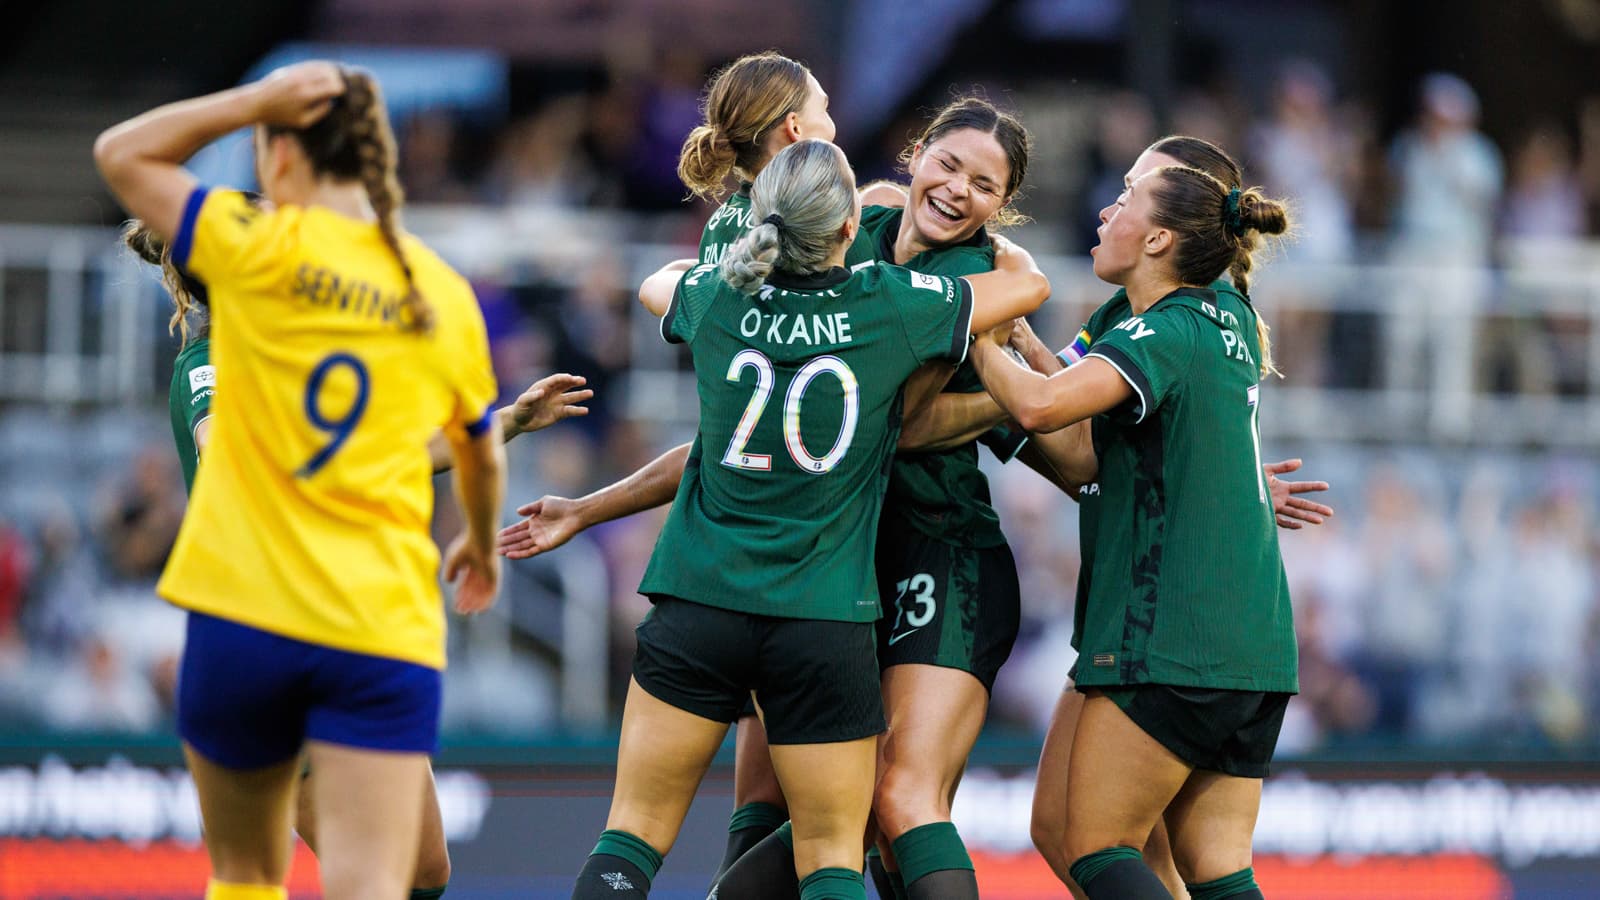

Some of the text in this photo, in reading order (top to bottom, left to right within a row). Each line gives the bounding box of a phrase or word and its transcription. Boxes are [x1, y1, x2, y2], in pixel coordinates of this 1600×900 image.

[740, 308, 852, 346] O'KANE
[1111, 316, 1156, 340] lly
[191, 389, 216, 406] TOYO
[295, 353, 370, 479] 9
[720, 348, 860, 475] 20
